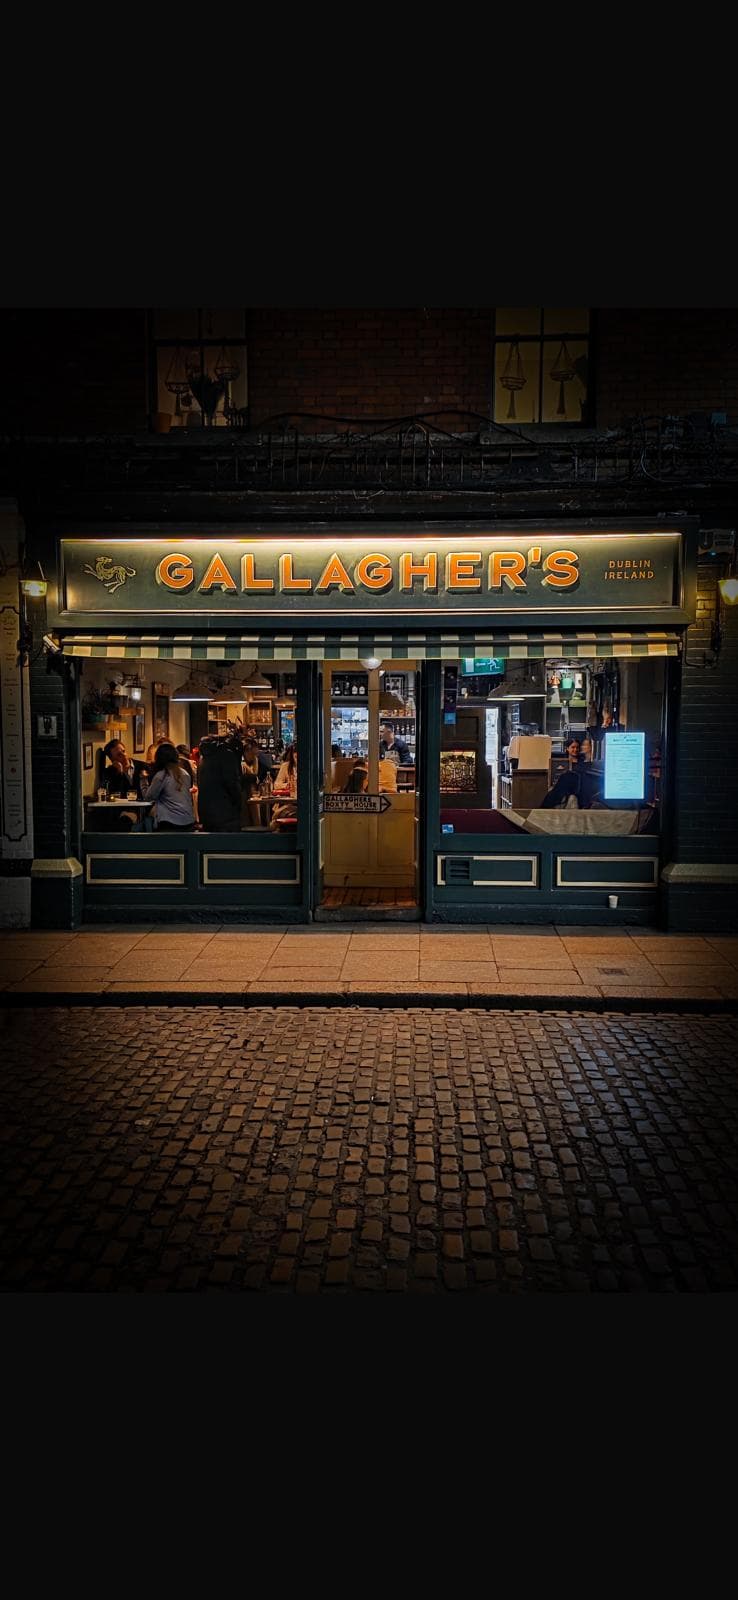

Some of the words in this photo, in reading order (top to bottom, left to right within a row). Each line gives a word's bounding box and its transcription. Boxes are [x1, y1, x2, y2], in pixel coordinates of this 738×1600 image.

[609, 560, 651, 569] DUBLIN
[156, 547, 580, 592] GALLAGHER'S
[604, 571, 654, 579] IRELAND
